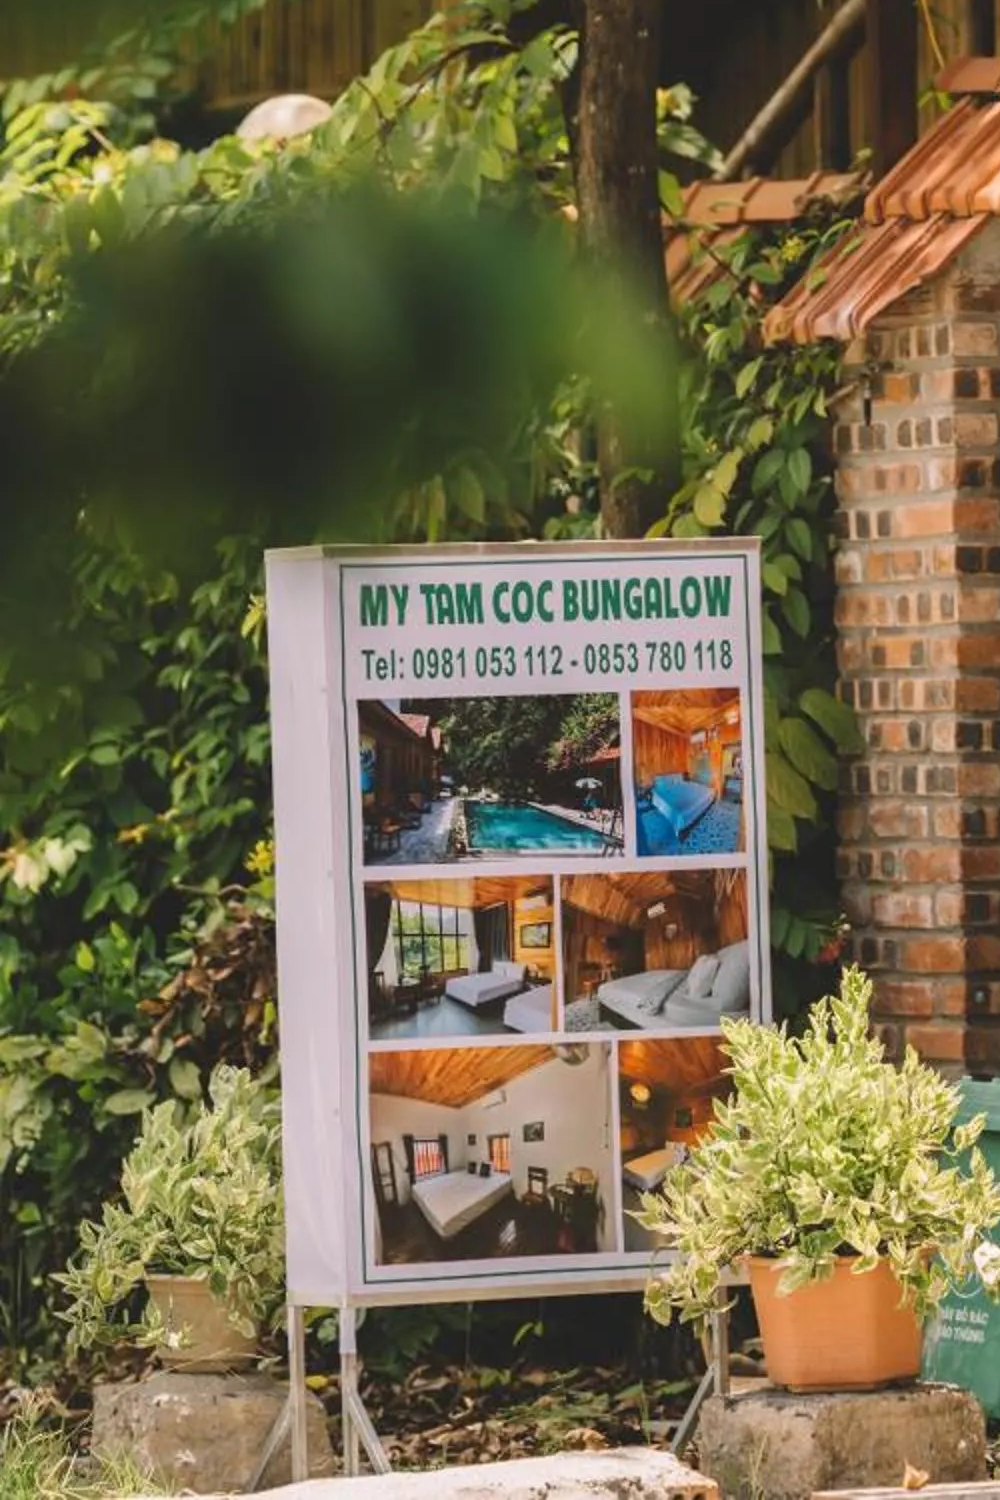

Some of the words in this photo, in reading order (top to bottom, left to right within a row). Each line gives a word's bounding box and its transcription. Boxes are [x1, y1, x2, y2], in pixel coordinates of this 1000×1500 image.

[360, 583, 408, 627] MY
[419, 582, 484, 625] TAM
[492, 579, 554, 624] COC
[563, 575, 732, 622] BUNGALOW
[361, 649, 404, 681] Tel:
[412, 647, 466, 679] 0981
[475, 646, 517, 677] 053
[524, 644, 563, 675] 112
[583, 641, 639, 674] 0853
[646, 640, 686, 672] 780
[694, 639, 733, 670] 118
